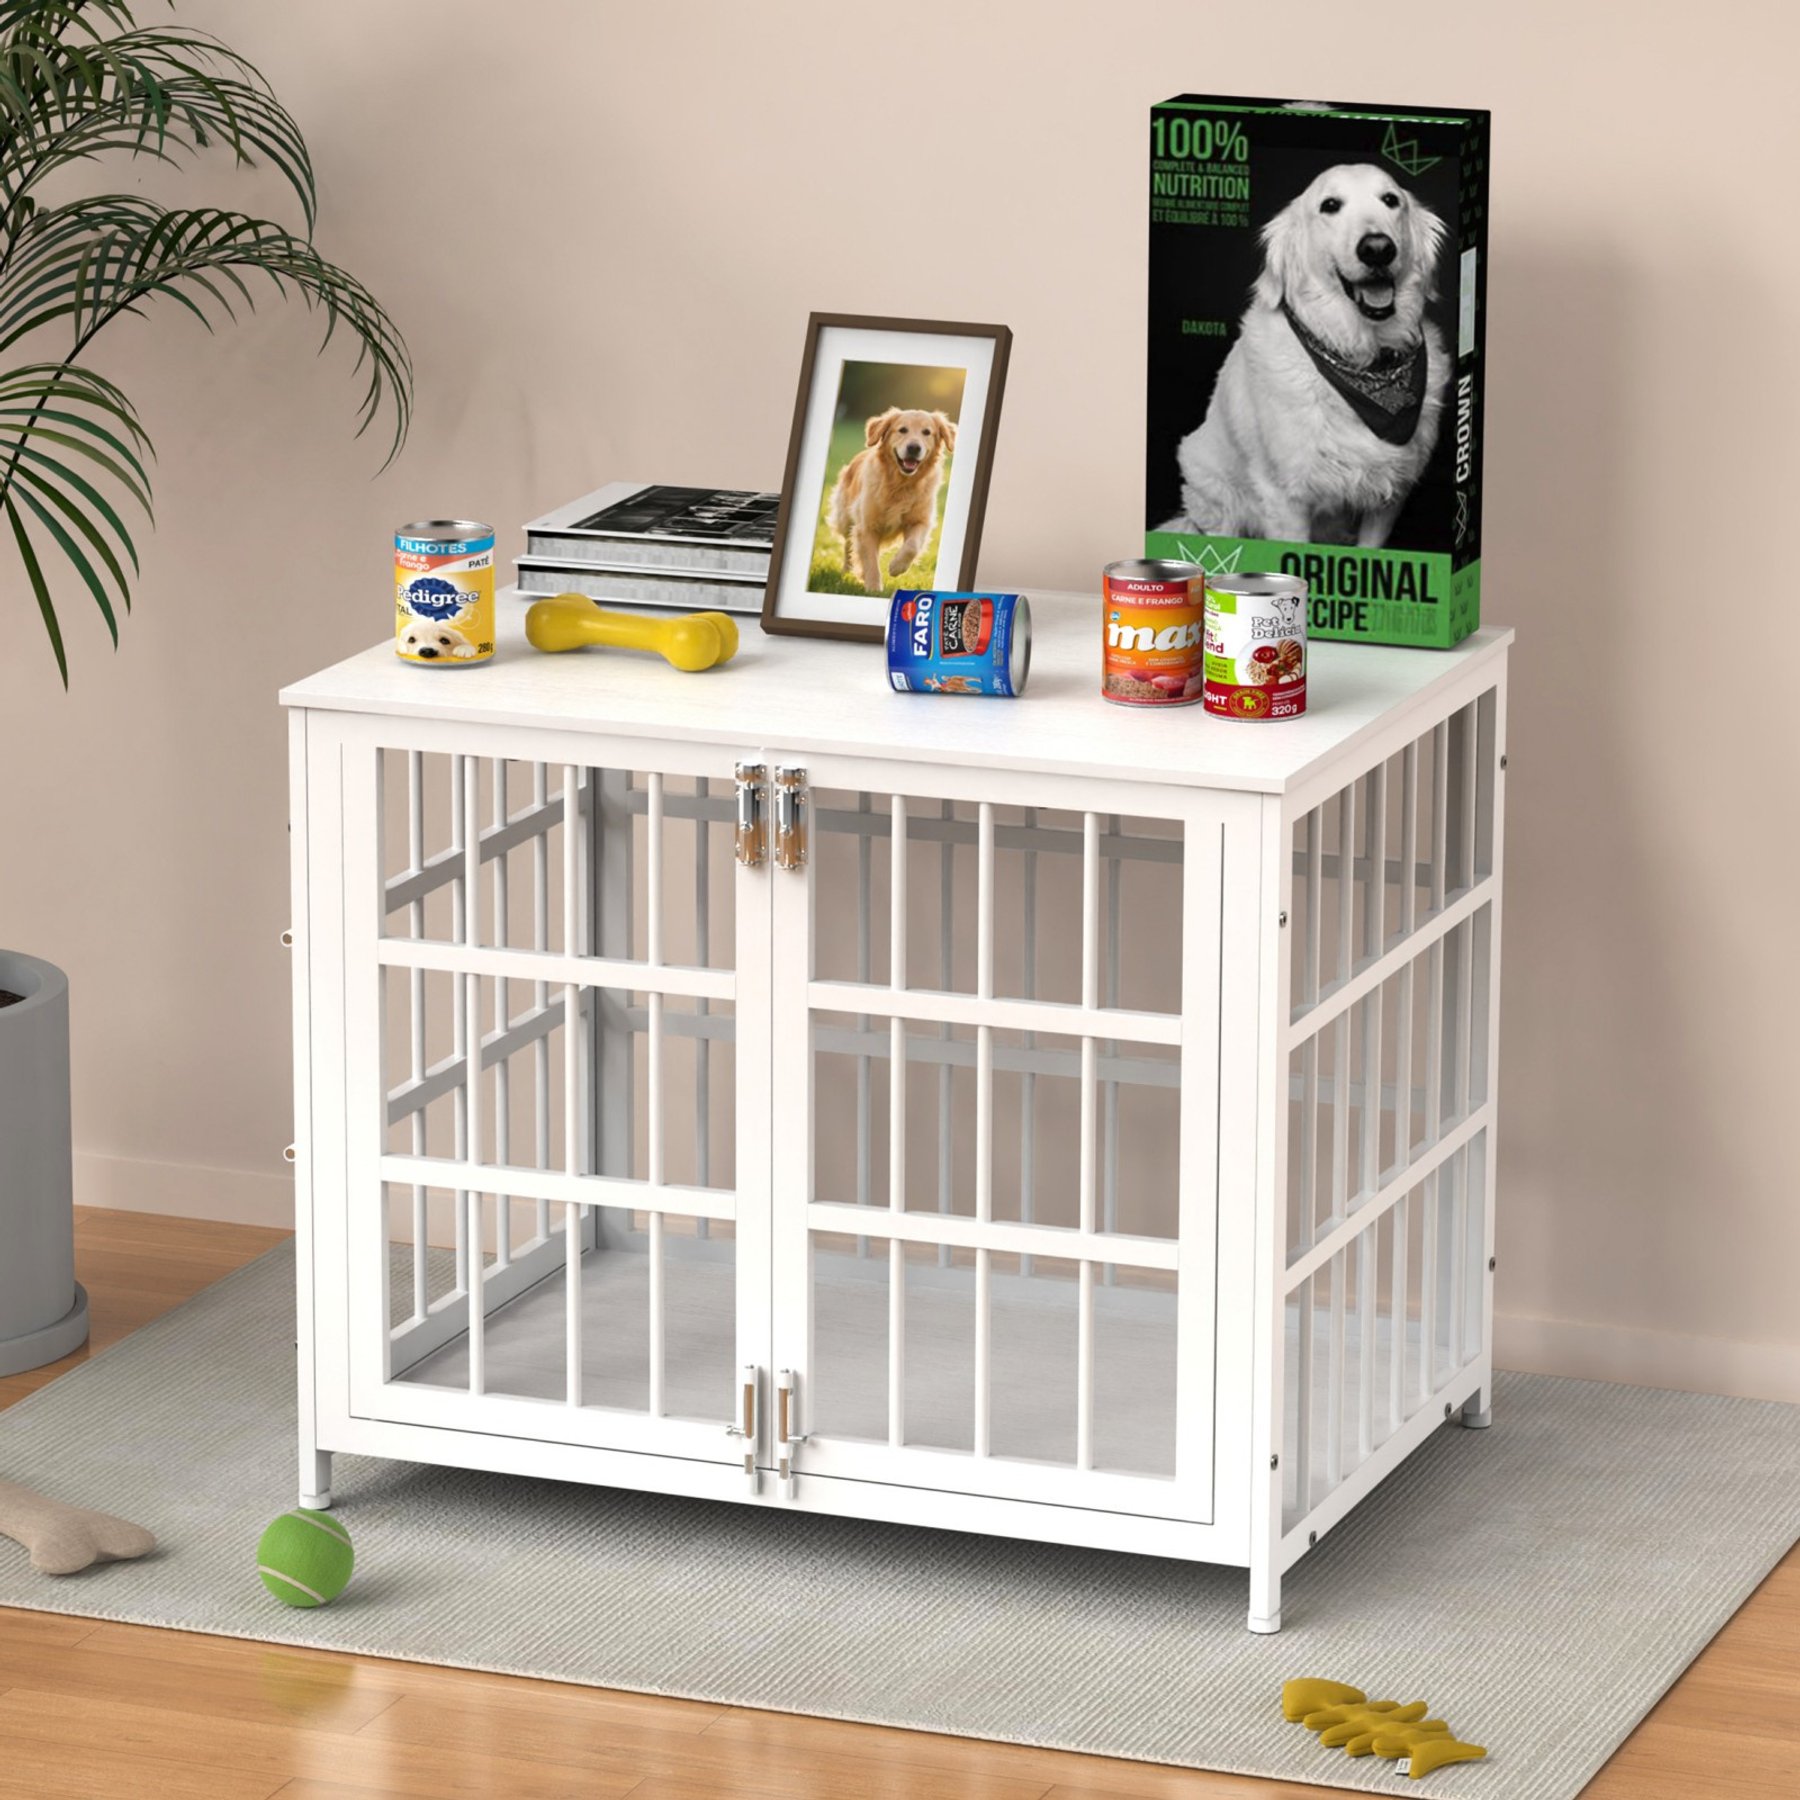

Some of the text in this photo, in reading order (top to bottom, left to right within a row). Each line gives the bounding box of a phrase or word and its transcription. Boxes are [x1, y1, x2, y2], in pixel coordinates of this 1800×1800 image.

[1152, 117, 1249, 162] 100%
[1154, 172, 1249, 200] NUTRITION
[1182, 319, 1227, 336] DAKOTA
[1456, 374, 1471, 484] CROWN
[400, 540, 468, 554] FILHOTES
[1127, 583, 1164, 592] ADULTO
[1280, 552, 1439, 604] ORIGINAL
[397, 584, 480, 607] Pedigree
[1112, 594, 1184, 606] CARNE E FRANGO
[913, 597, 933, 657] FARO
[1251, 616, 1280, 628] Pet
[1306, 597, 1369, 632] CIPE
[948, 605, 959, 650] CARNE
[1271, 703, 1298, 717] 320g
